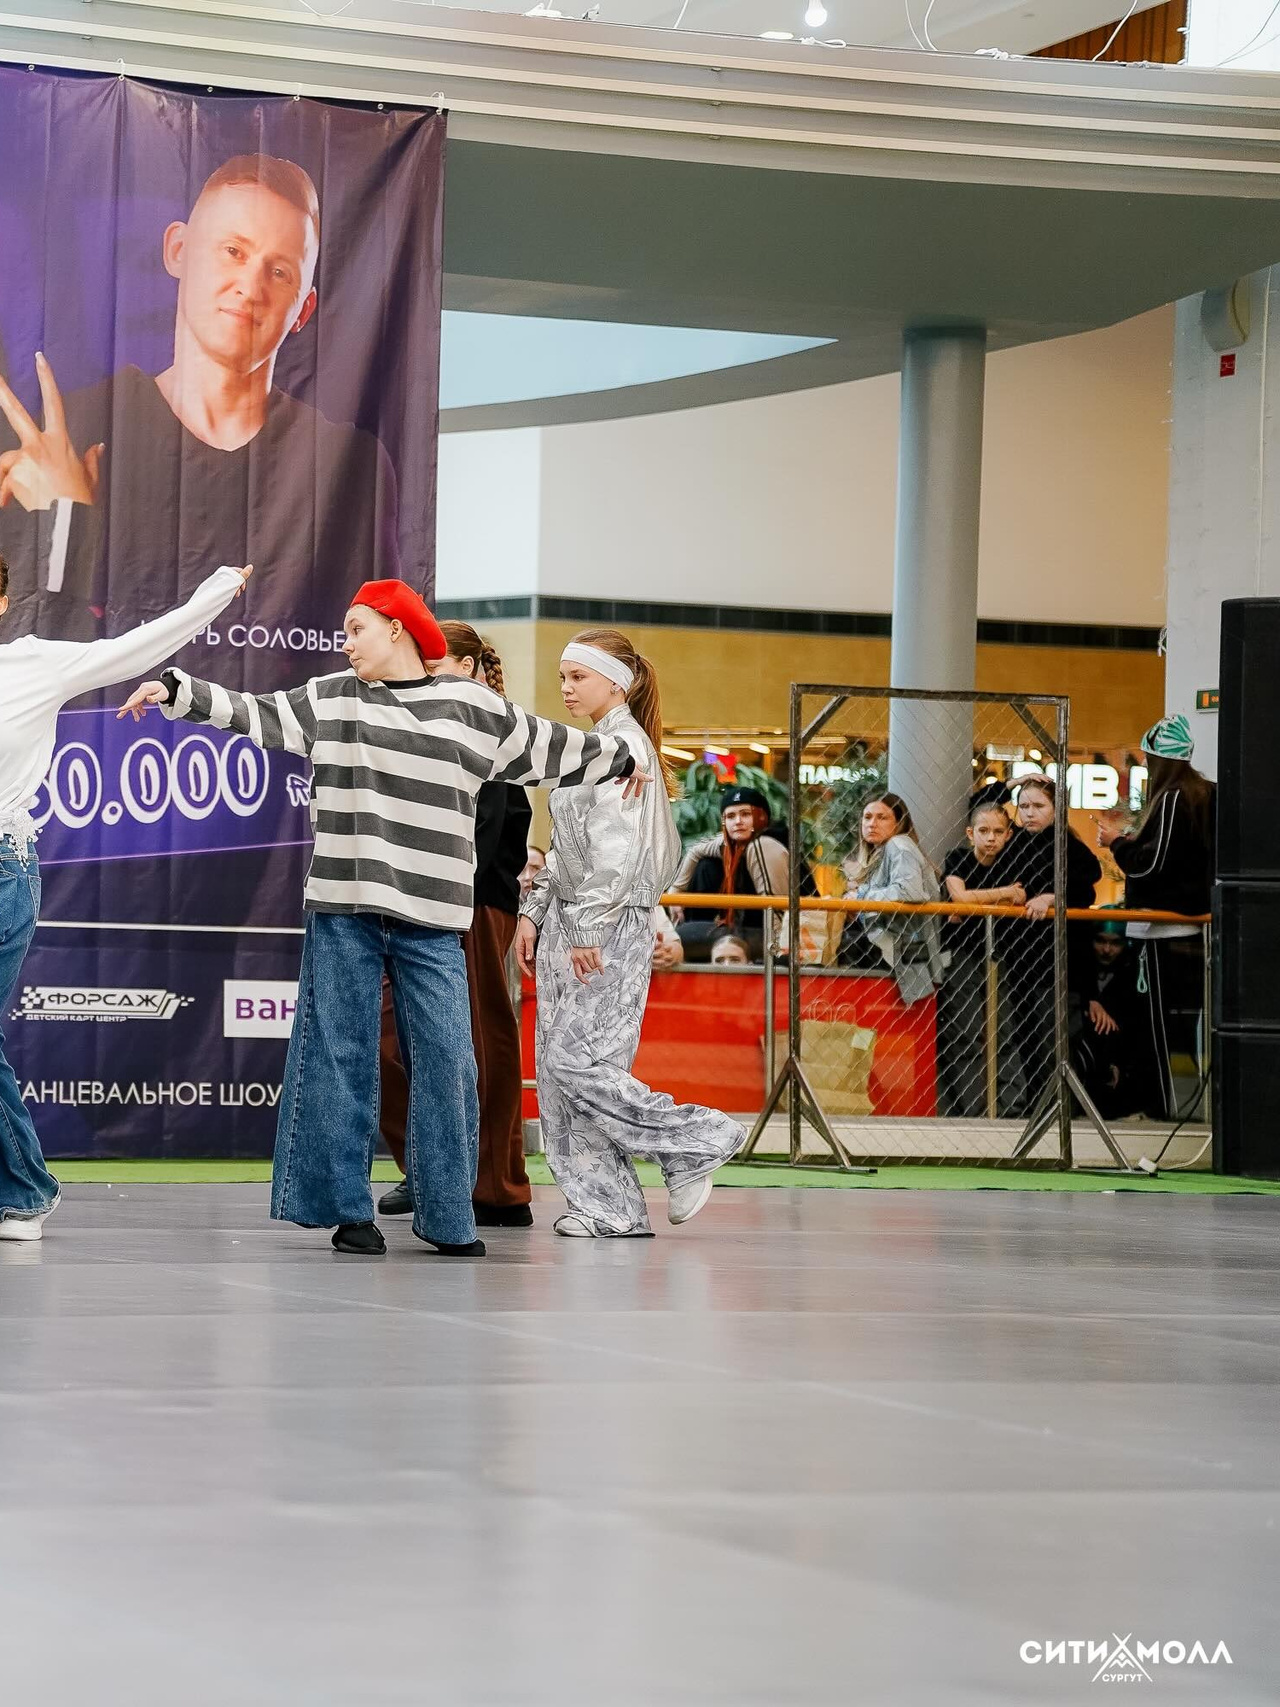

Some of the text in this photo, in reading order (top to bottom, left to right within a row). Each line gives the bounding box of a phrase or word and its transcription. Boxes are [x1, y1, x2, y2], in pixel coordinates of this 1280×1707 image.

[47, 992, 159, 1007] ФОРСАЖ
[25, 1013, 127, 1022] ДЕТСКИЙ КАРТ ЦЕНТР
[16, 1079, 283, 1107] АНЦЕВАЛЬНОЕ ШОУ
